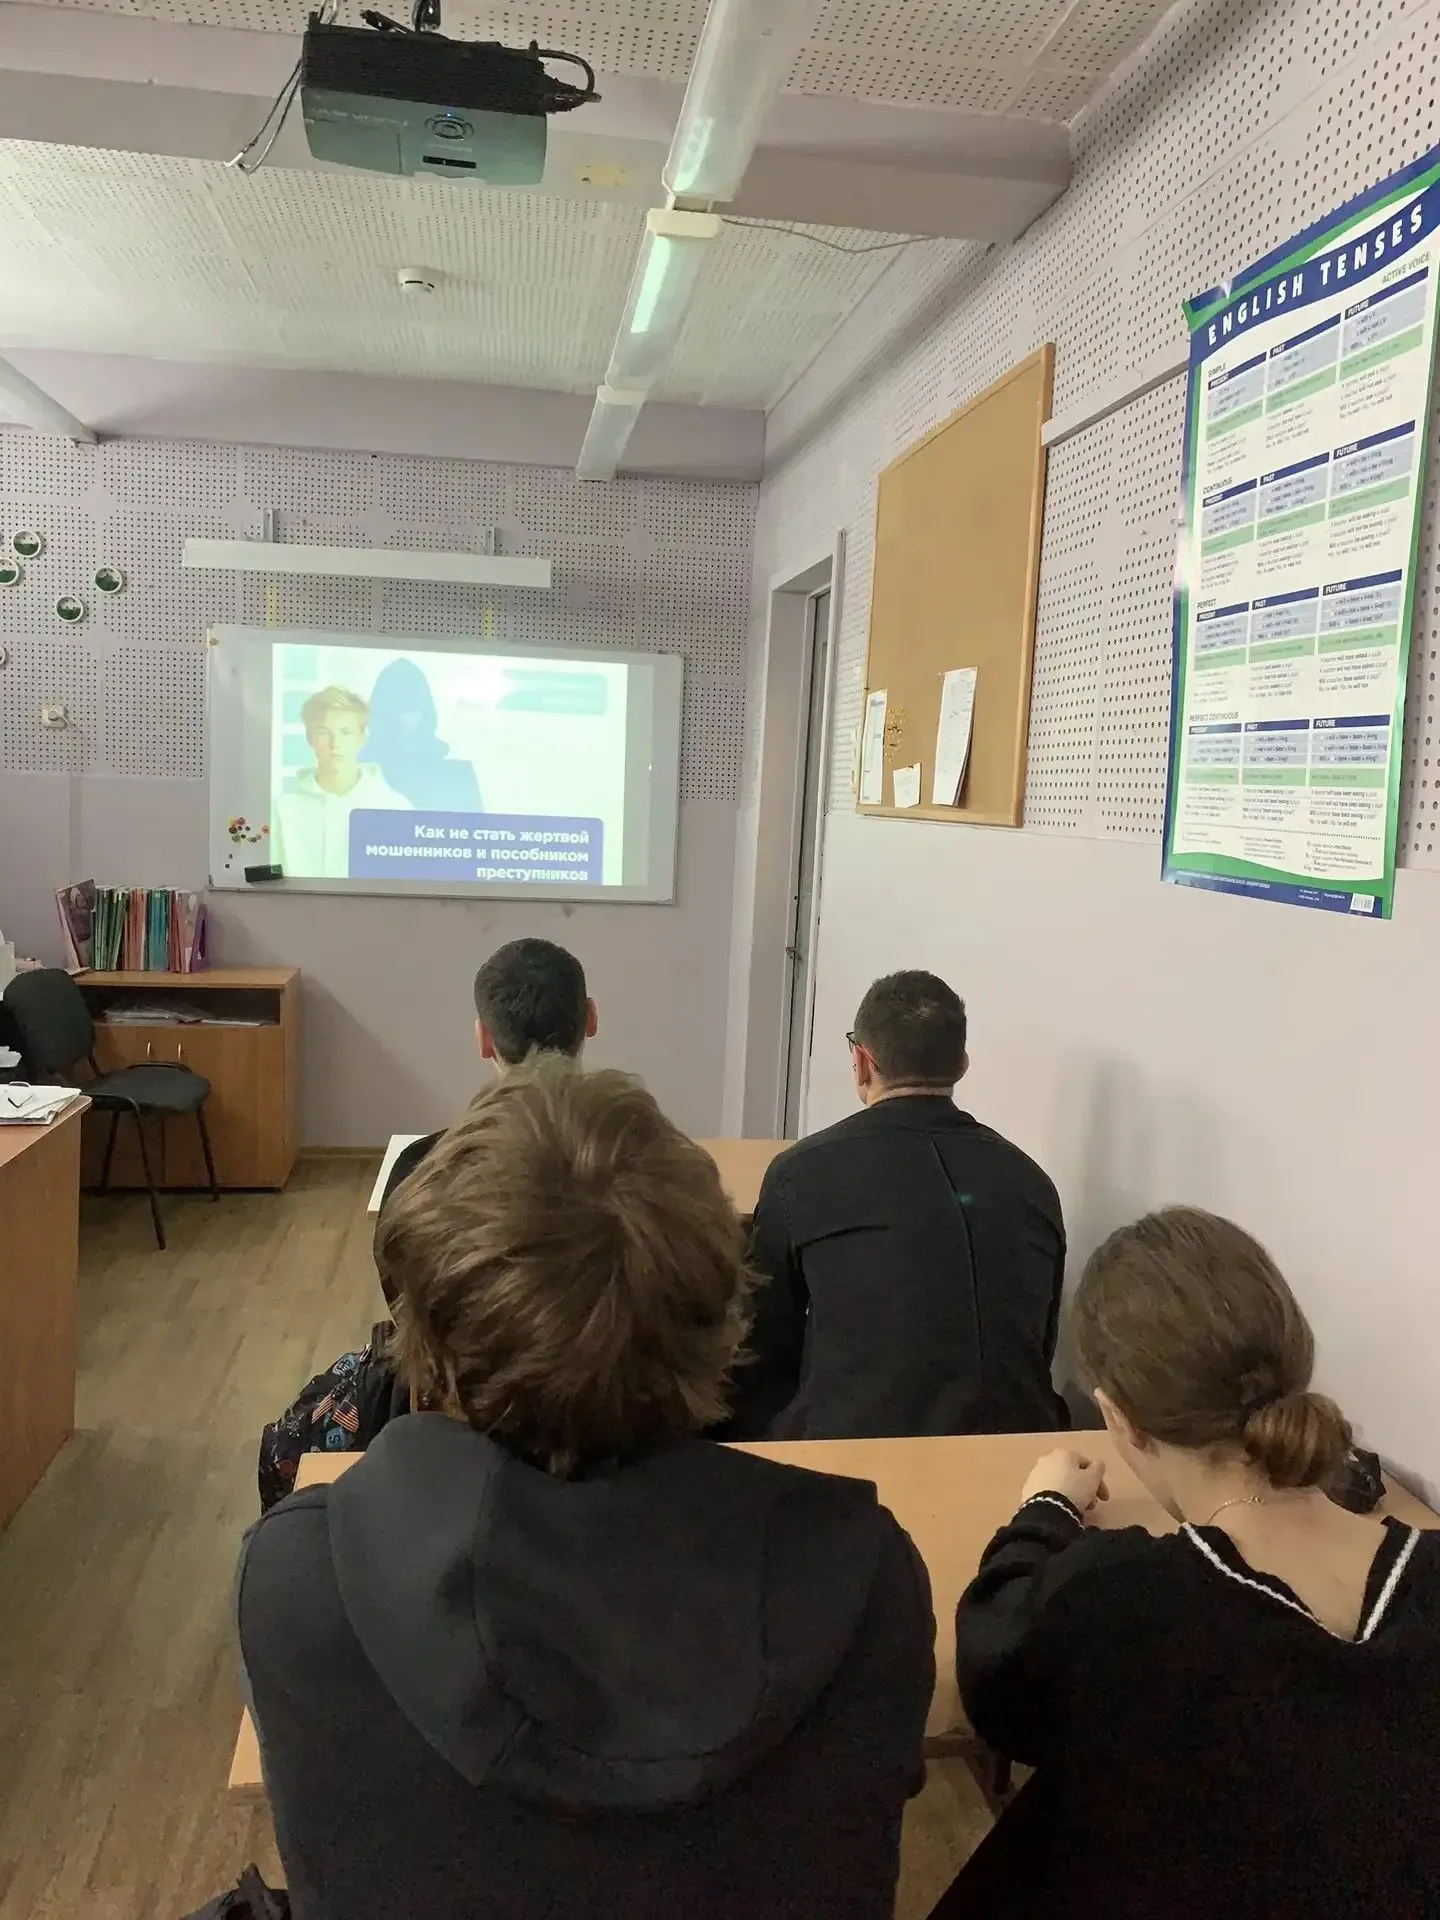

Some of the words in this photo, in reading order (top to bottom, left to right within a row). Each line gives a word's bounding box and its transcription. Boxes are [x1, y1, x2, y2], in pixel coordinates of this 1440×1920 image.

[1208, 273, 1303, 346] ENGLISH
[1320, 204, 1422, 286] TENSES
[1382, 263, 1408, 284] ACTIVE
[1408, 251, 1431, 273] VOICE
[1347, 299, 1369, 316] FUTURE
[1336, 443, 1358, 457] FUTURE
[1325, 582, 1347, 594] FUTURE
[1197, 598, 1216, 609] PERFECT
[1315, 719, 1336, 728] FUTURE
[414, 824, 445, 840] Как
[449, 828, 468, 840] не
[473, 829, 516, 842] стать
[519, 830, 590, 846] жертвой
[366, 844, 472, 859] мошенников
[476, 848, 487, 859] и
[491, 848, 589, 863] пособником
[476, 866, 589, 881] преступников
